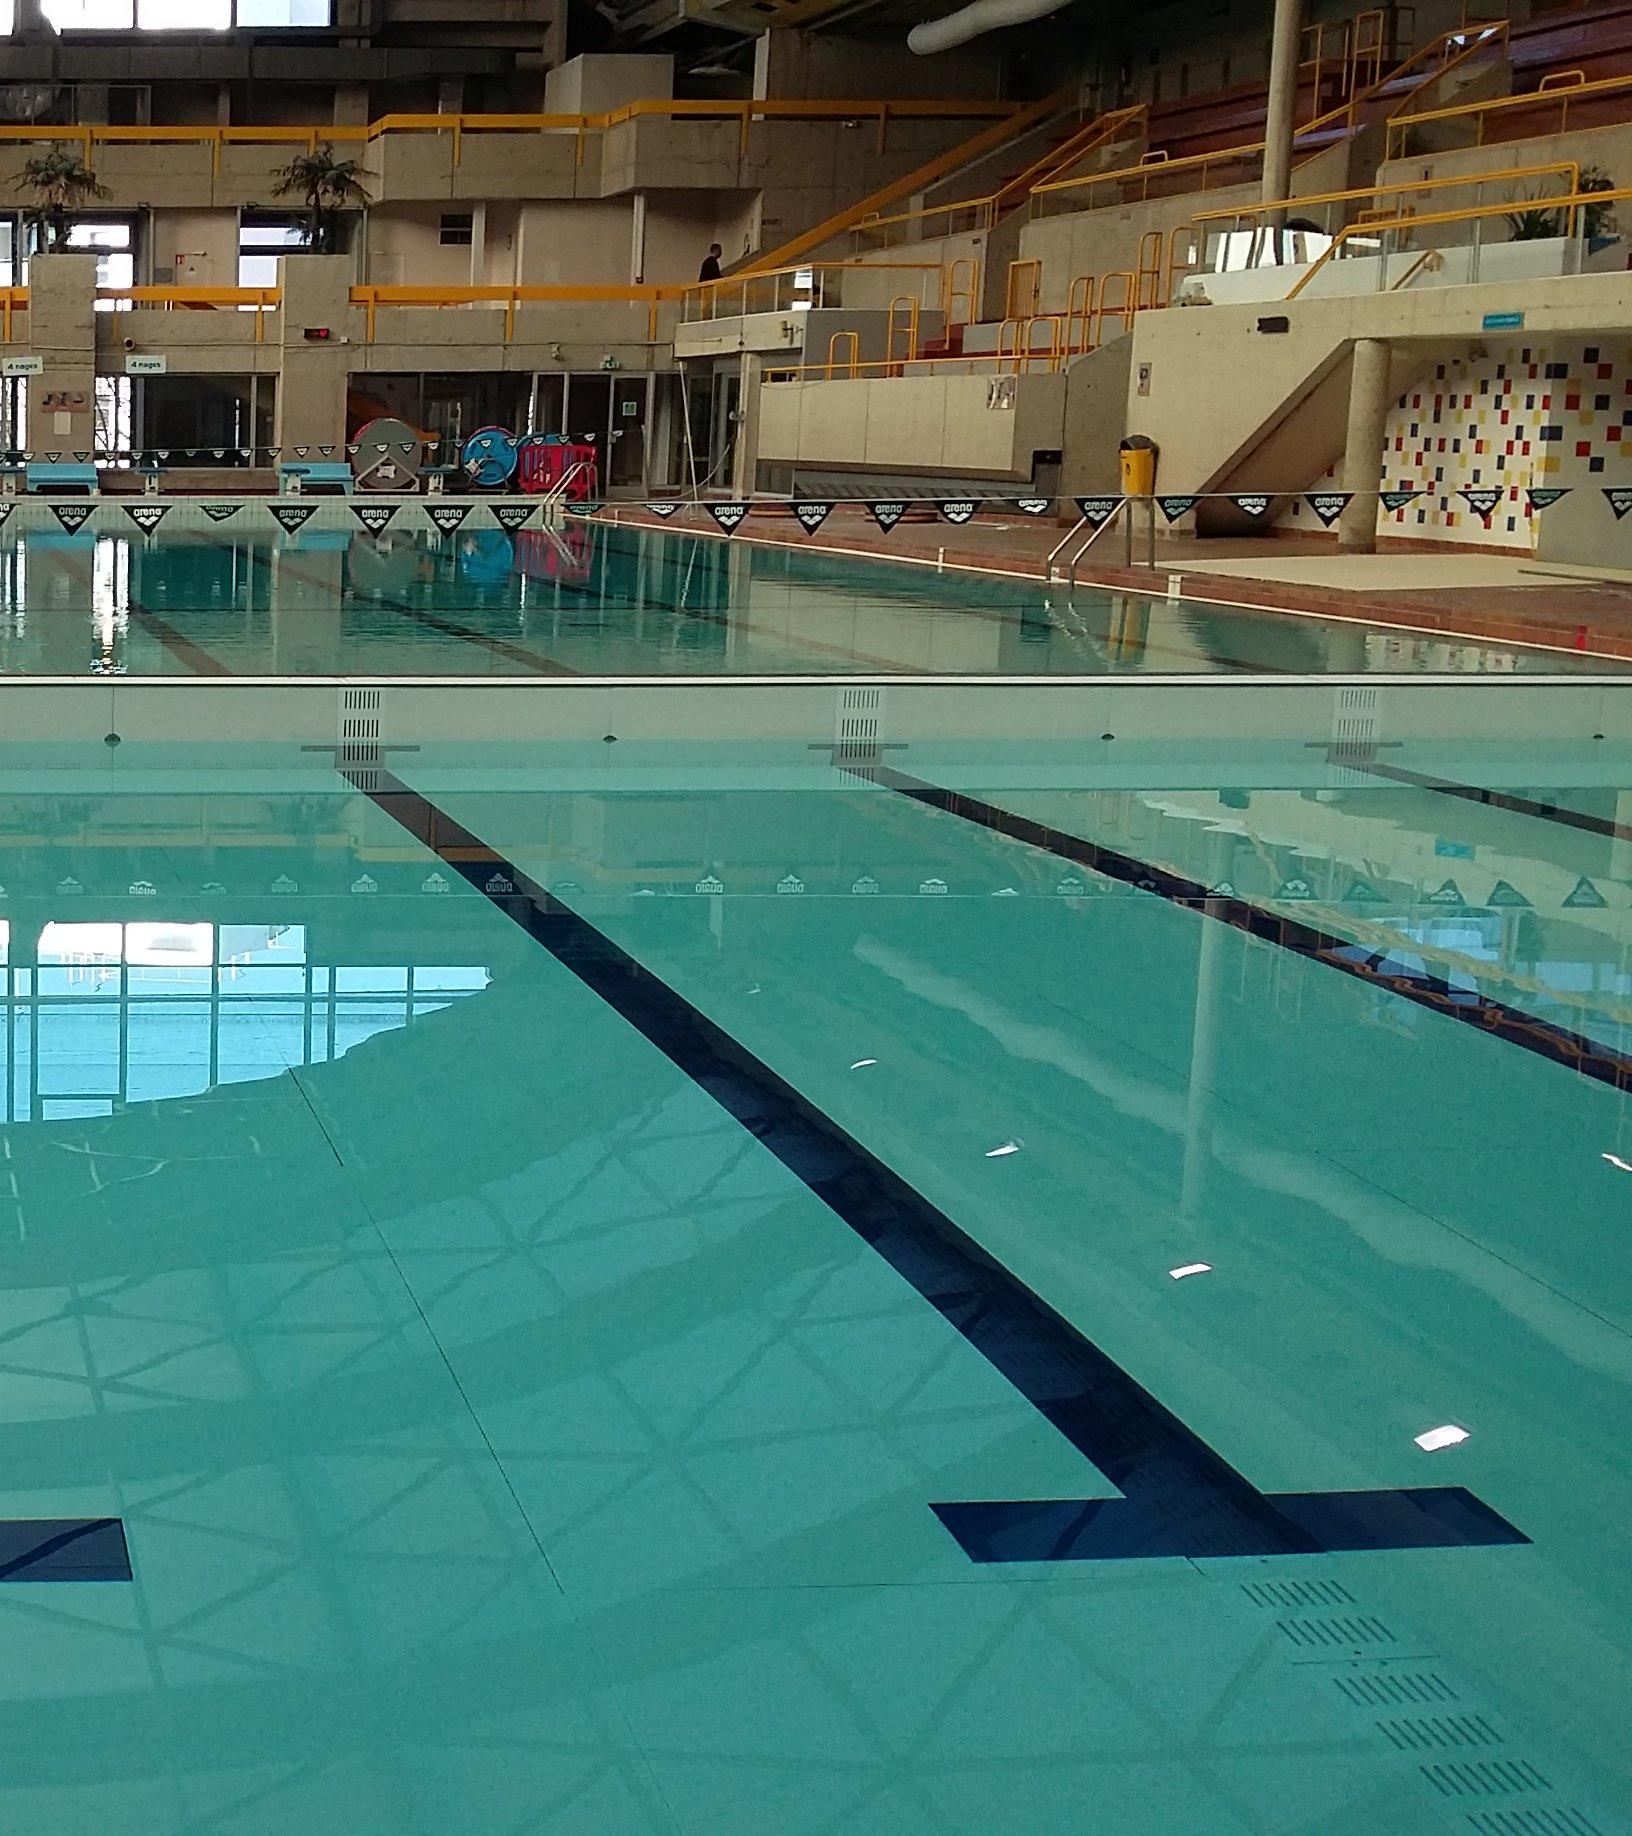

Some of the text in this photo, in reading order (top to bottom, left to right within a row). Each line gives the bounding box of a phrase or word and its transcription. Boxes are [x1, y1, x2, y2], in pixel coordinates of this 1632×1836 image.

[1084, 501, 1112, 511] arena
[1165, 498, 1192, 508] arena
[1238, 496, 1267, 506] arena
[1315, 496, 1343, 507] arena
[59, 506, 87, 516] arena
[133, 508, 162, 517] arena
[500, 508, 528, 518] arena
[715, 506, 744, 516] arena
[798, 505, 826, 515] arena
[875, 503, 903, 514] arena
[944, 503, 973, 513] arena
[279, 509, 307, 518] arena
[361, 509, 389, 519] arena
[434, 509, 462, 518] arena
